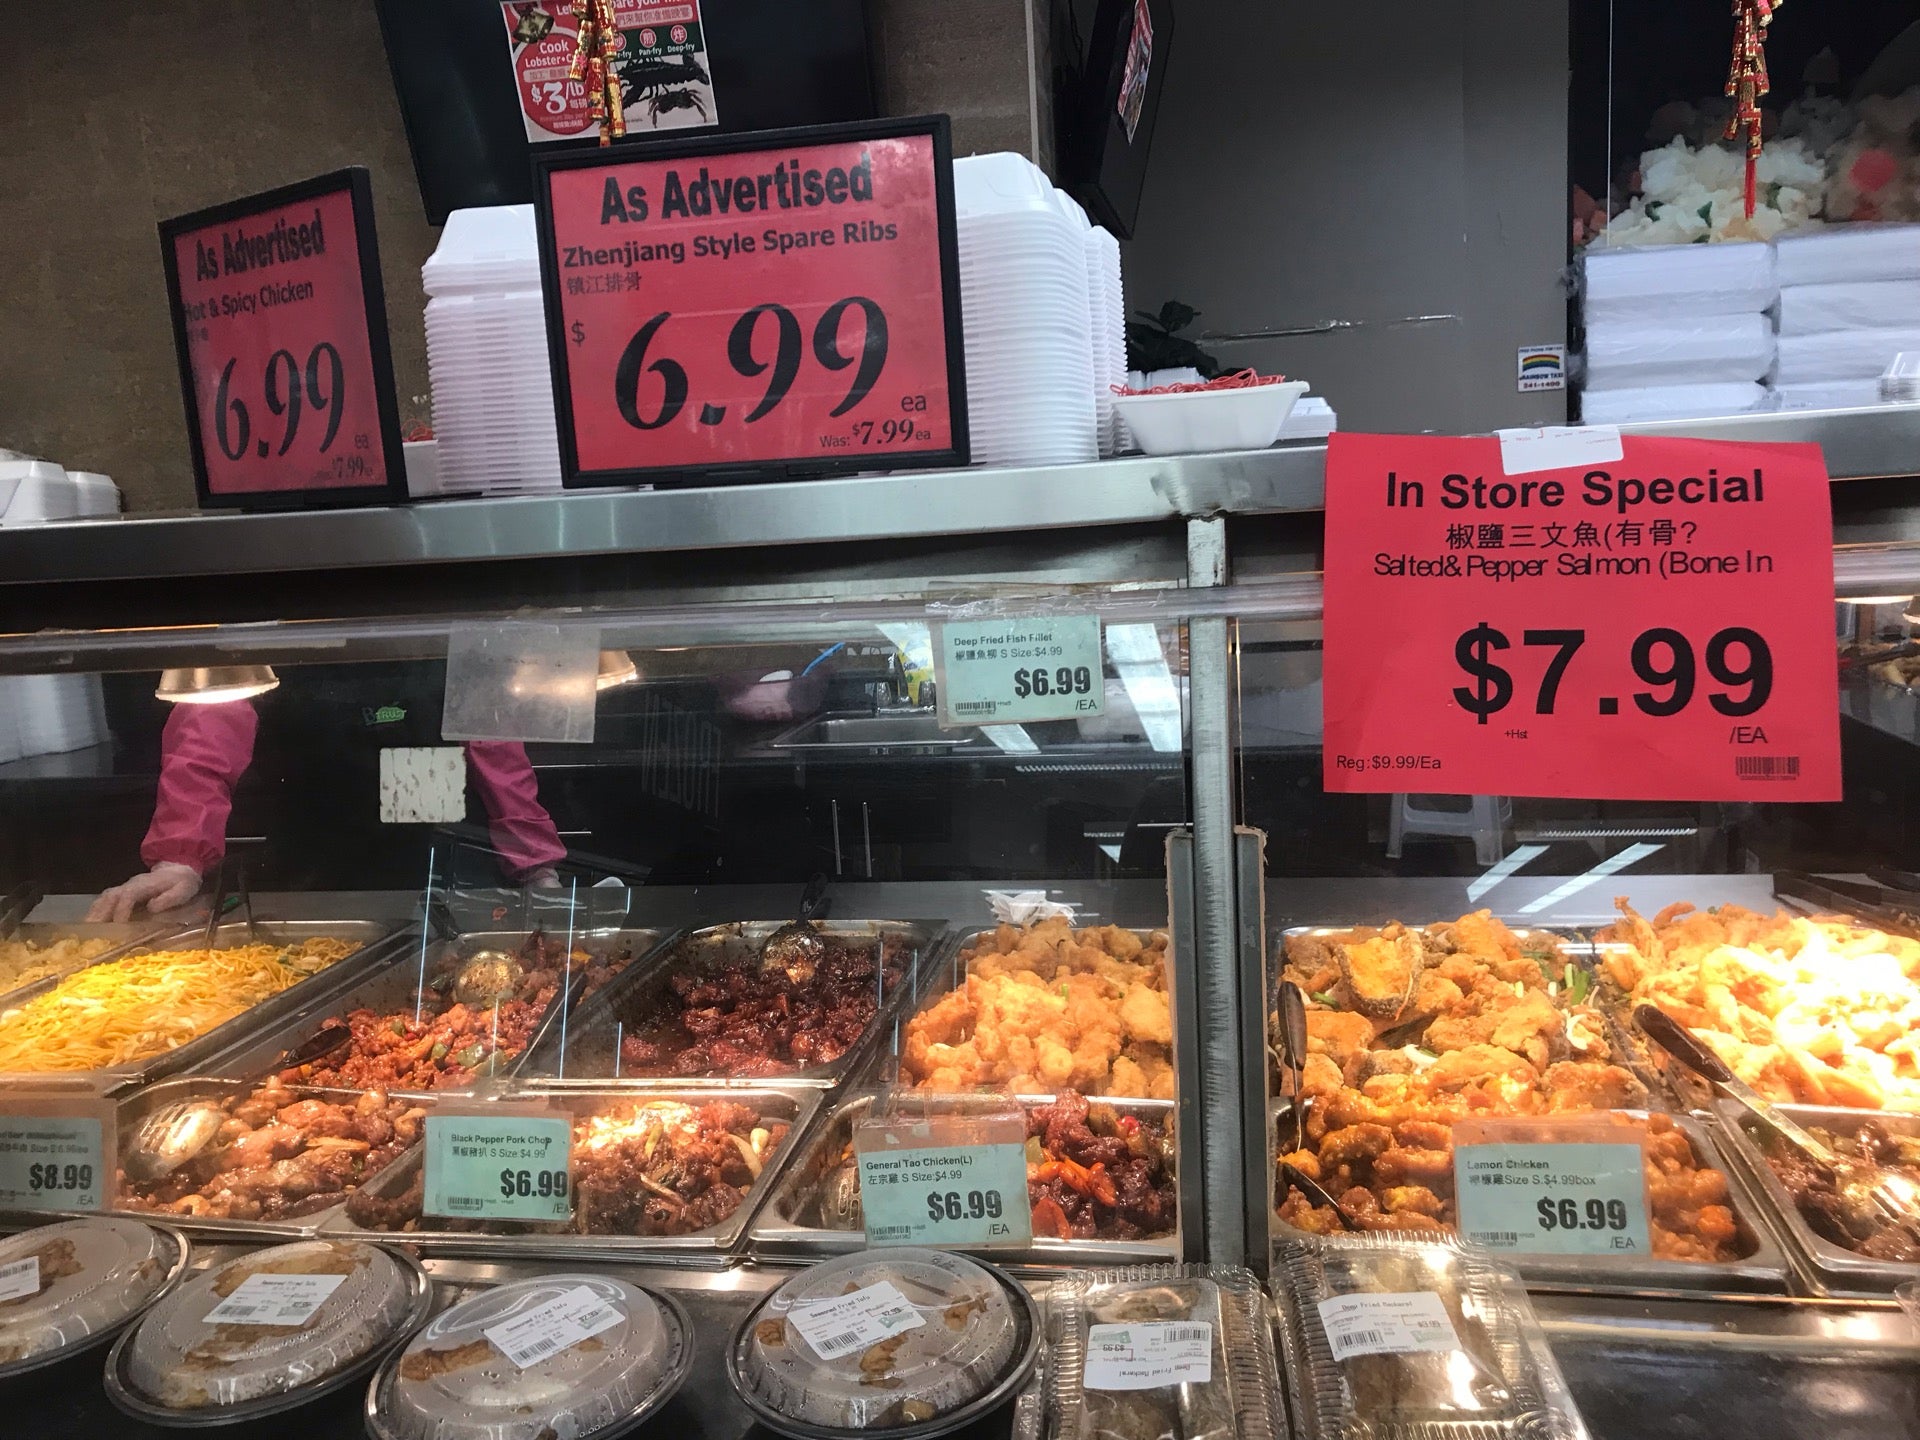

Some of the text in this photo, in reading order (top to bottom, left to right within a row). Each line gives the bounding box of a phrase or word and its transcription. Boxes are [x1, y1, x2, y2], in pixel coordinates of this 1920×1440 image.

[538, 39, 570, 54] Cook
[638, 45, 662, 57] Pan-fry
[667, 42, 696, 53] Deep-fry
[600, 152, 873, 225] As Advertised
[196, 208, 325, 282] As Advertised
[563, 221, 899, 268] Zhenjiang Style Spare Ribs
[566, 270, 642, 296] 镇江排骨
[208, 298, 219, 318] &
[221, 292, 257, 320] Spicy
[258, 279, 315, 308] Chicken
[571, 295, 890, 431] $ 6.99
[215, 341, 346, 462] 6.99
[901, 394, 928, 413] ea
[818, 433, 851, 449] Was:
[1386, 468, 1764, 514] In Store Special
[1556, 552, 1651, 577] Salmon
[953, 633, 1053, 647] Deep Fried Fish Fillet
[1000, 649, 1008, 659] S
[1014, 665, 1092, 699] $6.99
[1451, 621, 1775, 726] $7.99
[1075, 698, 1098, 712] /EA
[1729, 725, 1769, 745] /EA
[1335, 753, 1442, 772] Reg:$9.99/Ea
[450, 1134, 474, 1143] Black
[474, 1135, 505, 1144] Pepper
[506, 1136, 526, 1145] Pork
[490, 1148, 497, 1158] S
[866, 1155, 973, 1170] General Tao Chicken(L)
[1466, 1159, 1550, 1170] Lemon Chicken
[28, 1162, 93, 1191] $8.99
[500, 1168, 568, 1199] $6.99
[901, 1173, 909, 1183] S
[926, 1189, 1003, 1223] $6.99
[1536, 1196, 1628, 1231] $6.99
[988, 1223, 1010, 1236] /EA
[1610, 1236, 1636, 1249] /EA
